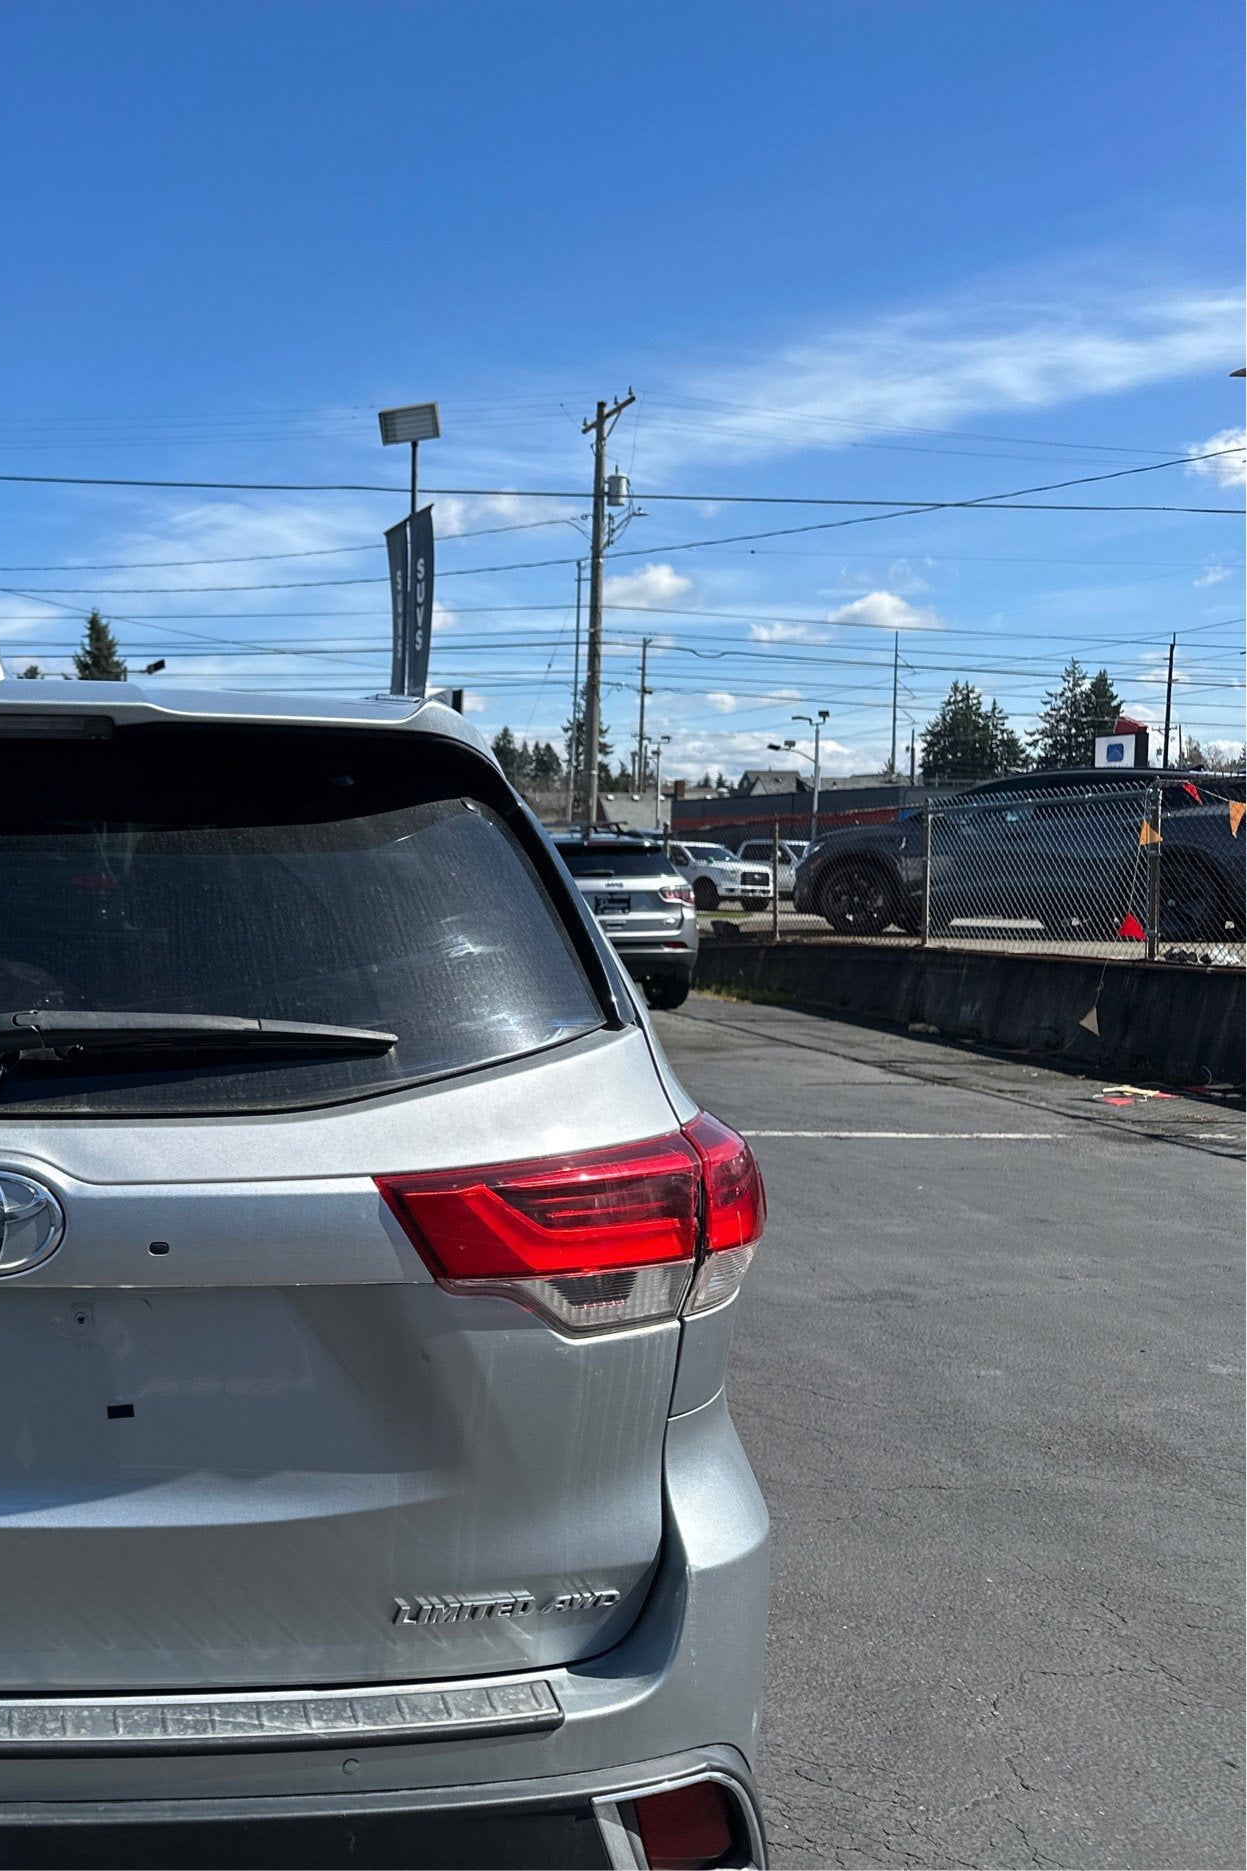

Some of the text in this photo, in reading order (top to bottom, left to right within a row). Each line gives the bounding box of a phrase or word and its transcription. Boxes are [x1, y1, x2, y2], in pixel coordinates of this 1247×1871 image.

[415, 557, 426, 651] SUVS
[393, 1589, 621, 1626] LIMITED AWD
